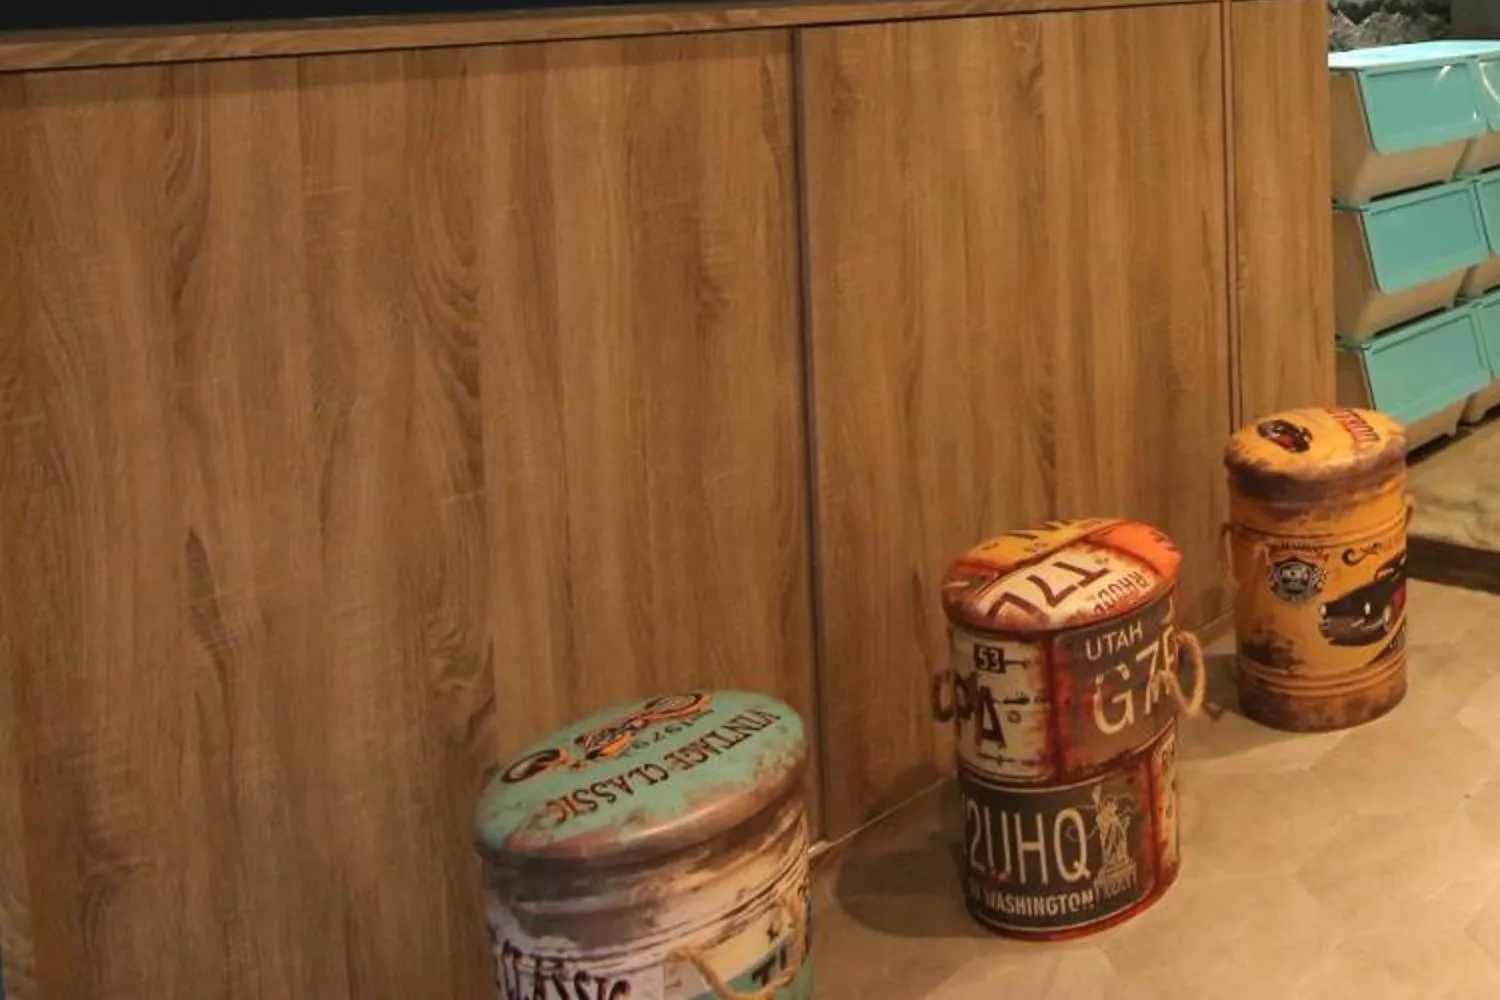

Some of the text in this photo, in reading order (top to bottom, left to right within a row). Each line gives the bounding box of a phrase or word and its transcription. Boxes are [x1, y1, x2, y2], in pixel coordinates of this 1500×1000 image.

[1085, 618, 1144, 661] UTAH
[977, 646, 1001, 672] 53
[546, 708, 782, 824] VINTAGE CLASSIC
[984, 887, 1094, 917] WASHINGTON
